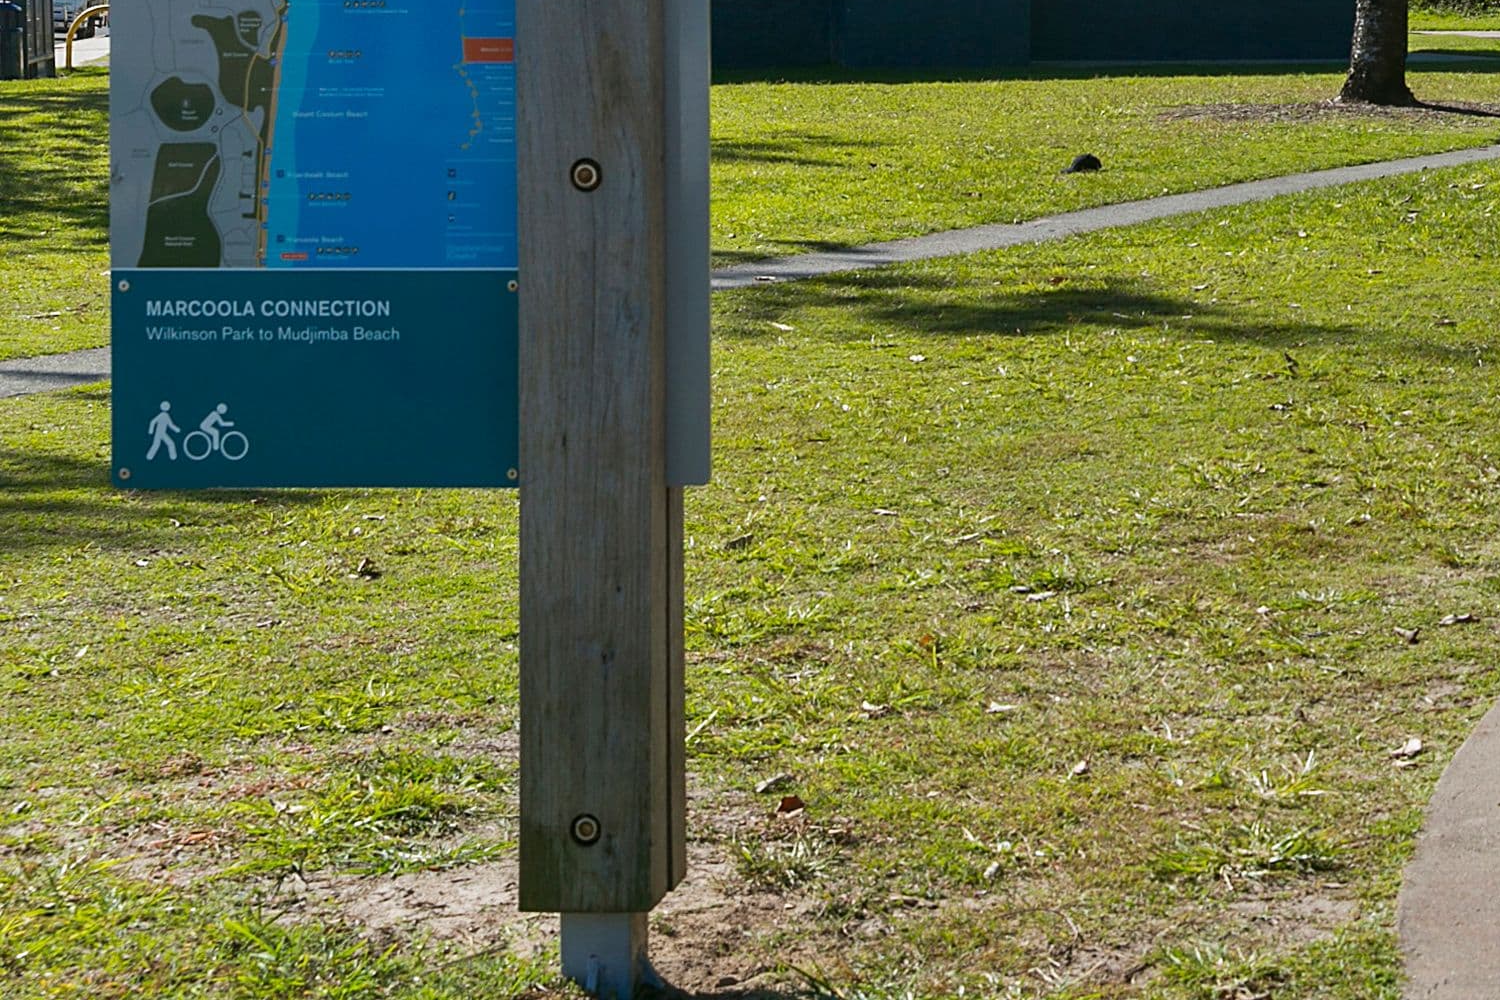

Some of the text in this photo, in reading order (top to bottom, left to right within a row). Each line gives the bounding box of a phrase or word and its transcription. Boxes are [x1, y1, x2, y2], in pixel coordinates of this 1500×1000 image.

[146, 300, 390, 317] MARCOOLA CONNECTION
[146, 327, 400, 345] Wilkinson Park to Mudjimba Beach
